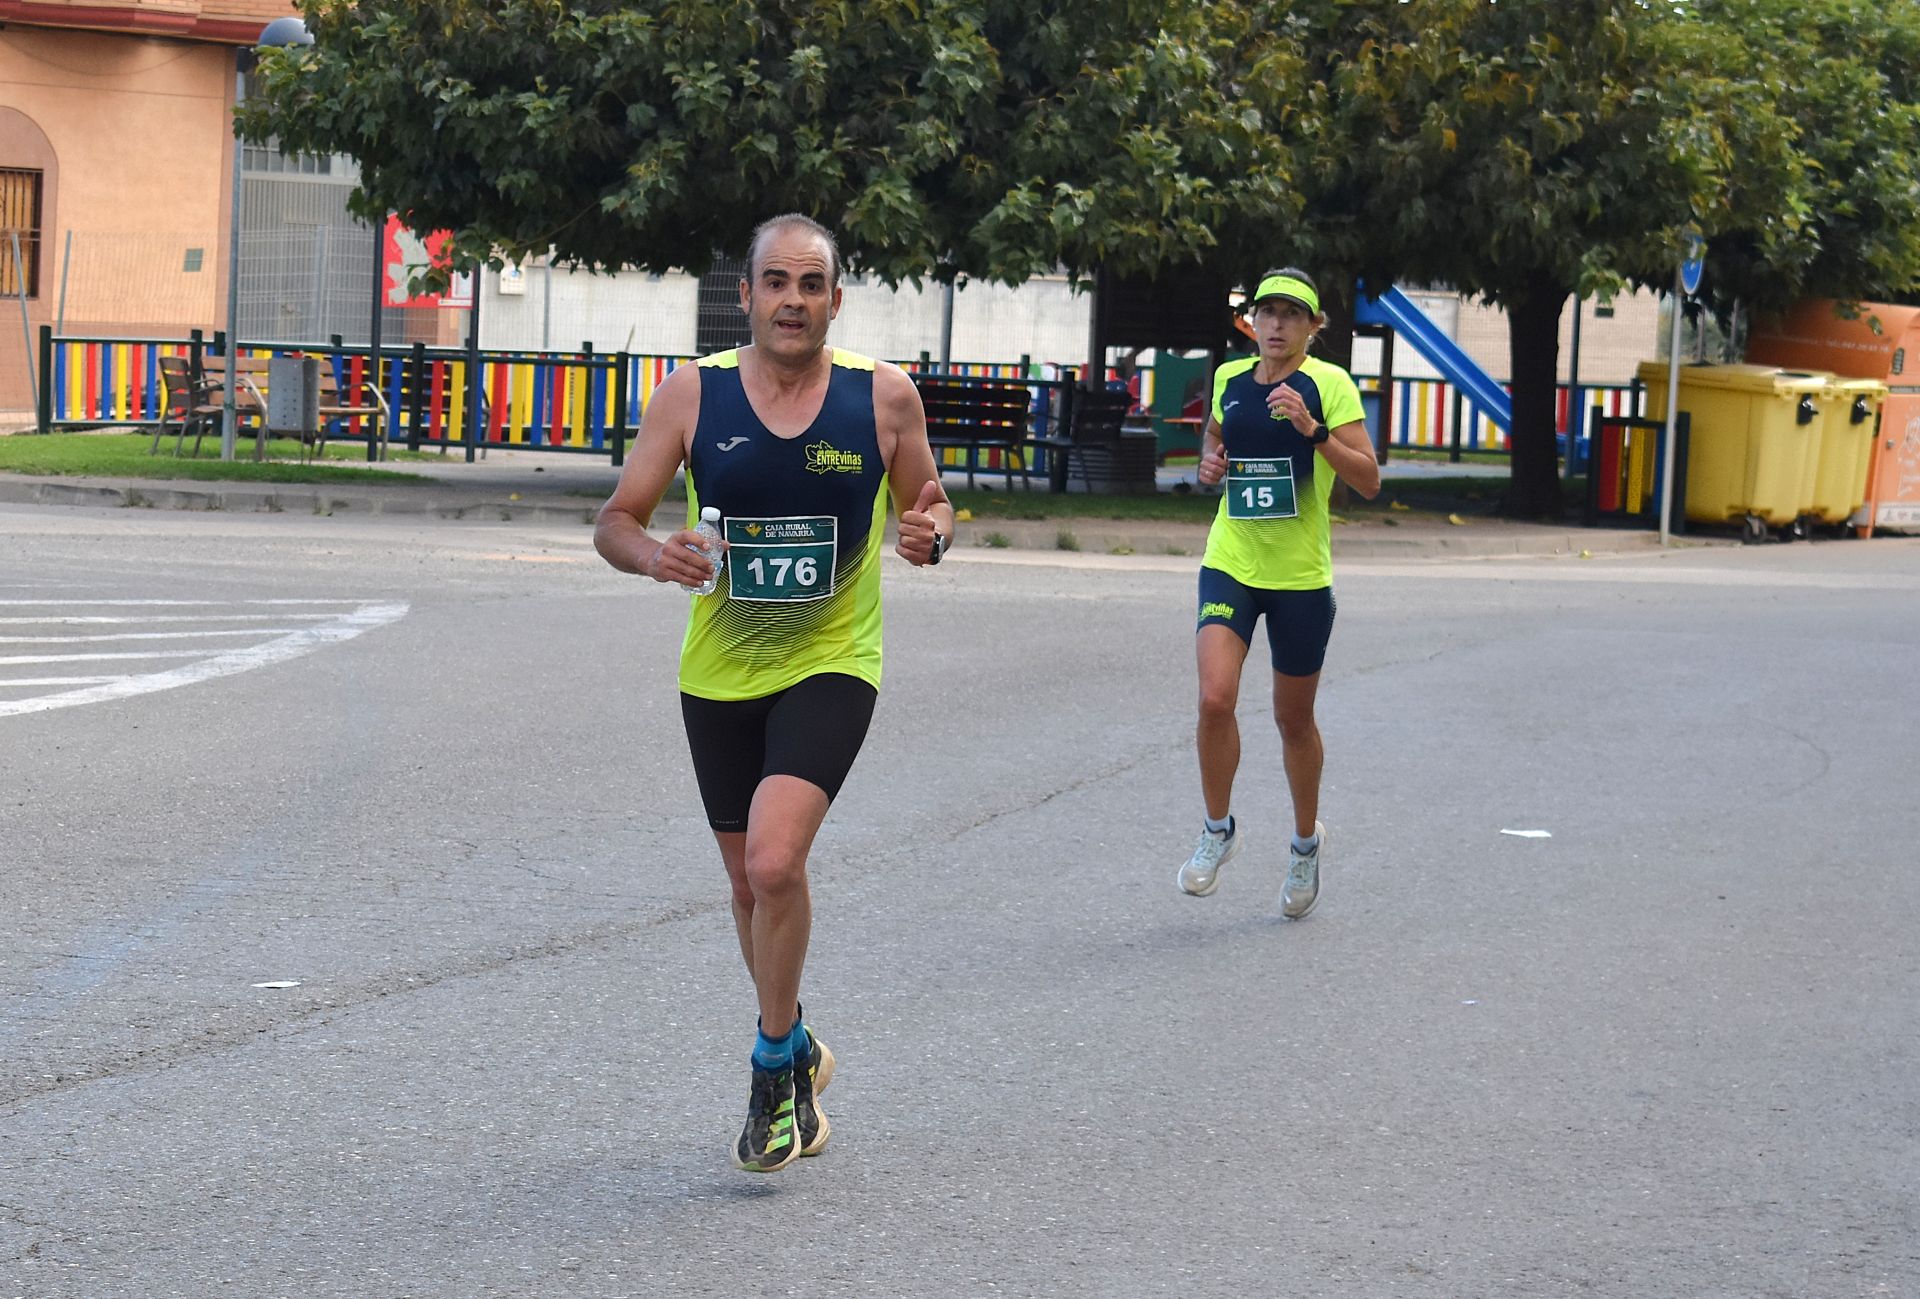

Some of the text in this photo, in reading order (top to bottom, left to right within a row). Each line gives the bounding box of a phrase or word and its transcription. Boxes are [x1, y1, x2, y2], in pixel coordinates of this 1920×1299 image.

[1241, 487, 1274, 508] 15
[778, 530, 815, 538] NAVARRA
[747, 557, 817, 586] 176
